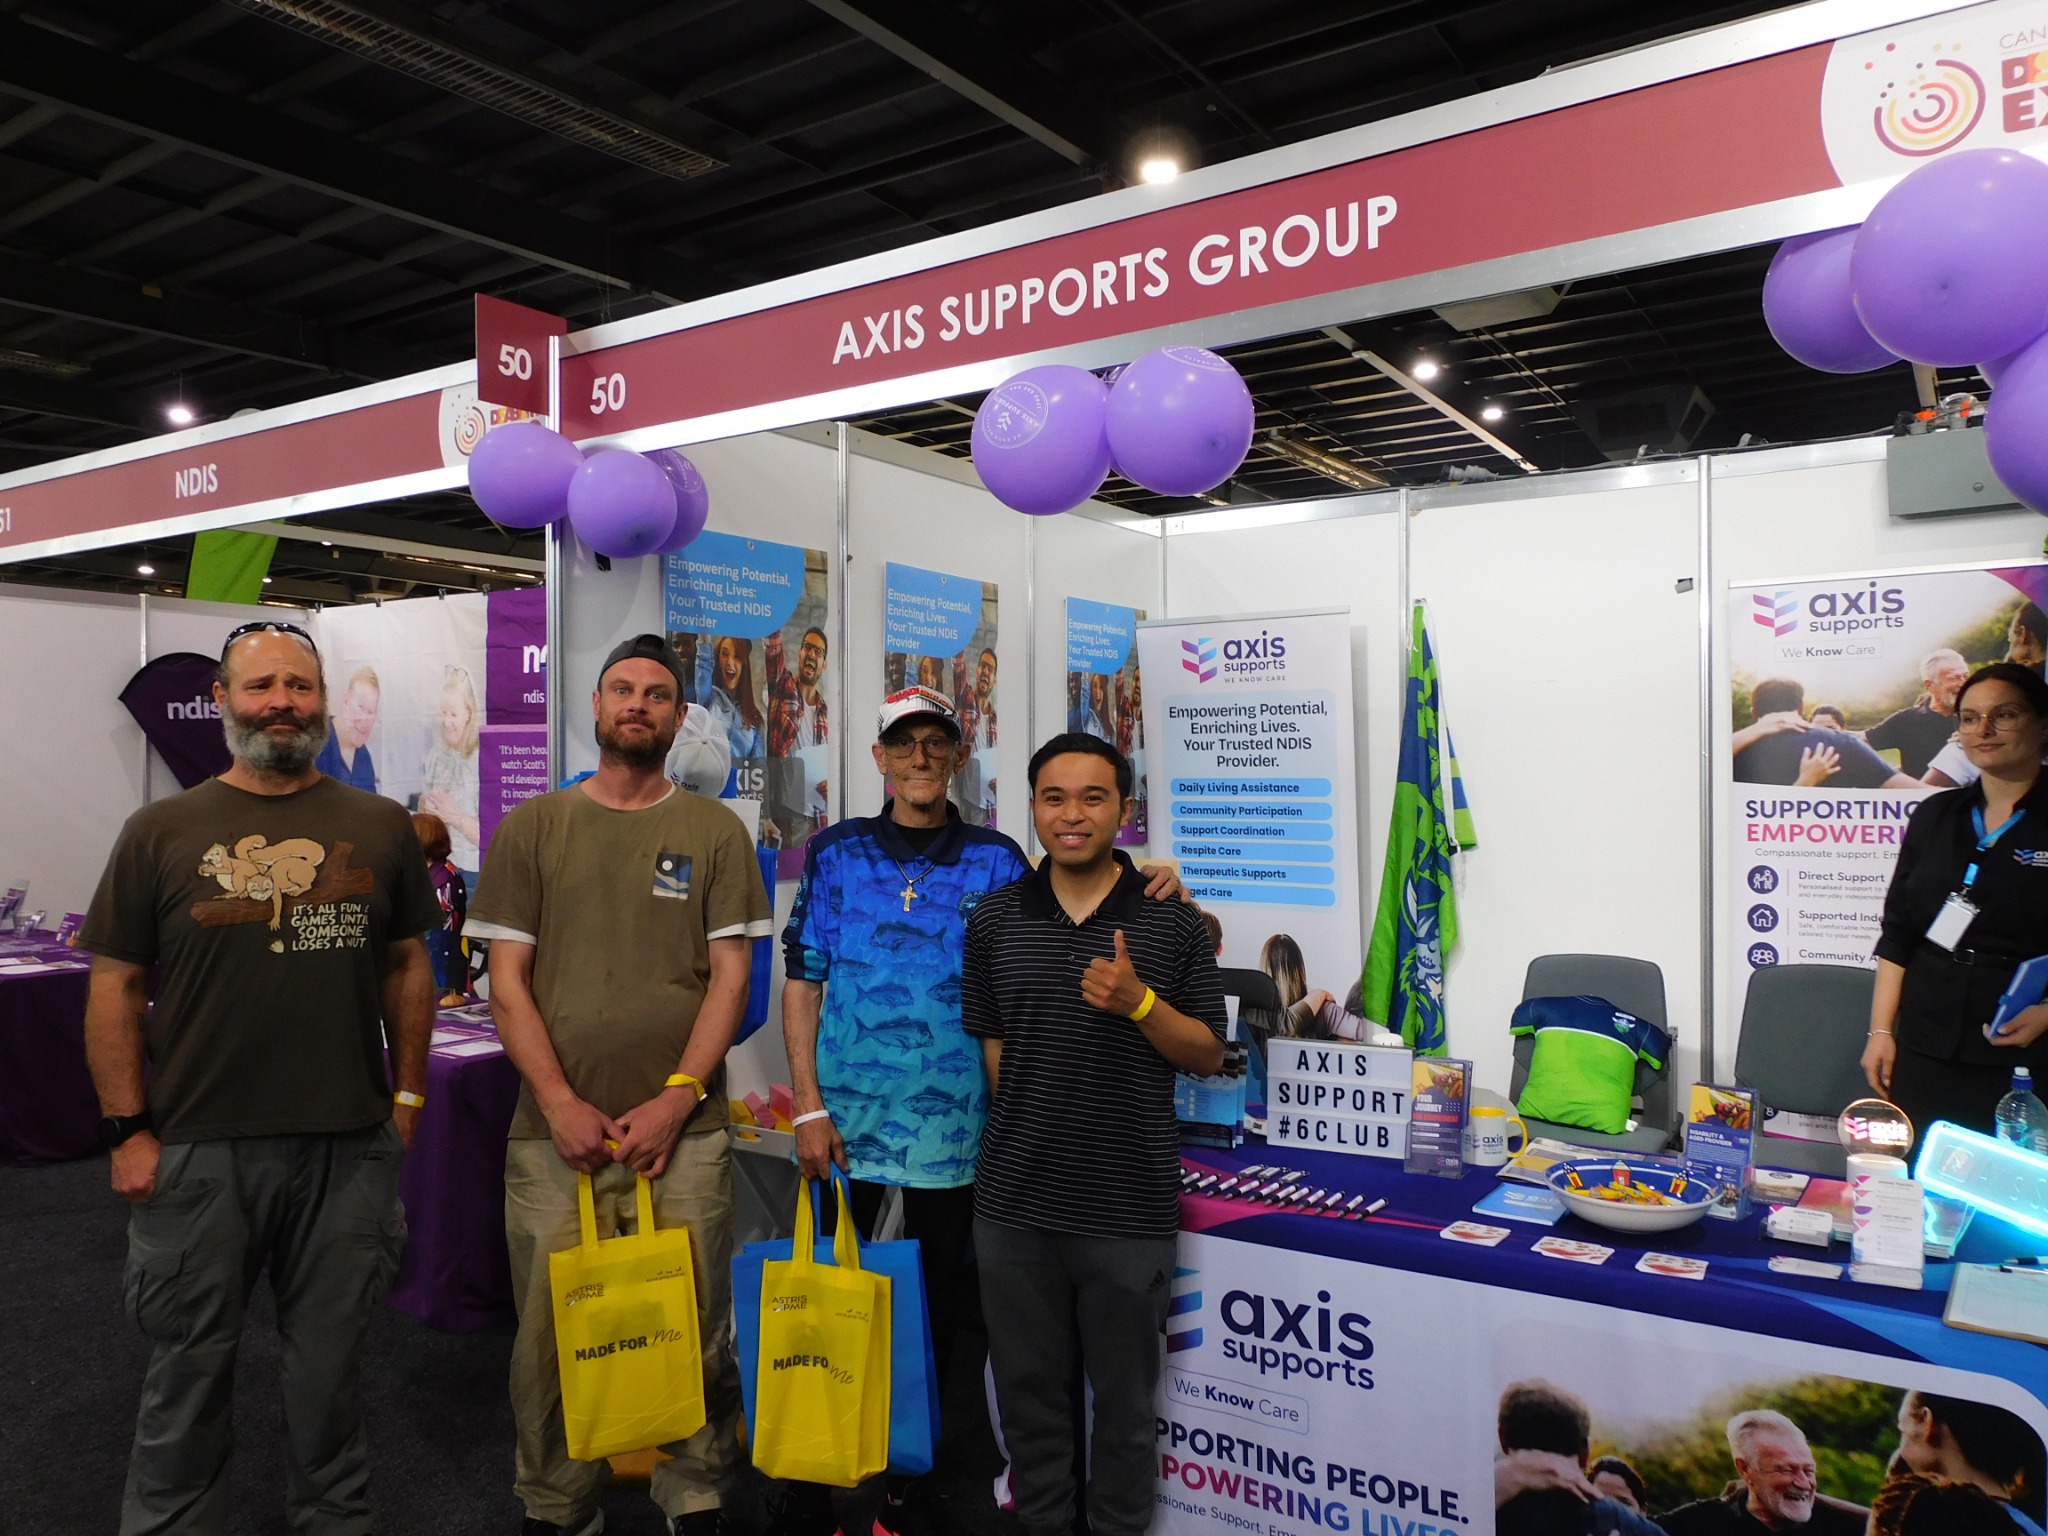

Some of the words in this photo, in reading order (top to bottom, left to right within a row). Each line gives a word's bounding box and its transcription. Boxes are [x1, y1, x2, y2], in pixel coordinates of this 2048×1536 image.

[832, 304, 924, 365] AXIS
[938, 246, 1170, 342] SUPPORTS
[1188, 194, 1398, 286] GROUP
[498, 344, 532, 380] 50
[590, 372, 626, 414] 50
[175, 463, 218, 499] NDIS
[669, 556, 739, 581] Empowering
[742, 566, 791, 588] Potential,
[669, 574, 723, 596] Enriching
[726, 580, 757, 598] Lives:
[669, 592, 696, 607] Your
[699, 596, 740, 614] Trusted
[744, 603, 772, 617] NDIS
[888, 588, 936, 610] Empowering
[937, 597, 972, 615] Potential,
[1809, 581, 1905, 618] axis
[669, 611, 718, 628] Provider
[887, 604, 924, 623] Enriching
[887, 619, 907, 632] Your
[908, 622, 937, 637] Trusted
[938, 627, 958, 640] NDIS
[1809, 615, 1904, 635] supports
[887, 635, 920, 649] Provider
[1223, 630, 1286, 660] axis
[1782, 648, 1803, 658] We
[1806, 646, 1843, 657] Know
[1845, 645, 1876, 656] Care
[1224, 658, 1286, 675] supports
[523, 691, 545, 704] ndis
[167, 696, 223, 720] ndis
[1169, 703, 1257, 720] Empowering
[1260, 701, 1328, 716] Potential,
[1190, 720, 1258, 736] Enriching
[1261, 719, 1300, 733] Lives.
[513, 745, 531, 755] been
[1183, 739, 1215, 751] Your
[1218, 737, 1273, 750] Trusted
[1276, 737, 1312, 750] NDIS
[501, 759, 522, 769] watch
[1216, 754, 1280, 767] Provider.
[501, 774, 514, 784] and
[681, 780, 699, 791] axis
[1179, 782, 1205, 795] Daily
[1207, 782, 1238, 795] Living
[1241, 783, 1300, 793] Assistance
[1180, 805, 1237, 817] Community
[1239, 806, 1303, 818] Participation
[1180, 825, 1219, 837] Support
[1220, 826, 1285, 836] Coordination
[1181, 845, 1216, 857] Respite
[1218, 846, 1241, 856] Care
[1755, 848, 1833, 859] Compassionate
[1836, 850, 1880, 860] support.
[1884, 850, 1900, 860] Em
[1182, 866, 1239, 878] Therapeutic
[1241, 868, 1286, 880] Supports
[1798, 870, 1834, 881] Direct
[1837, 871, 1885, 884] Support
[1190, 888, 1208, 897] ged
[1210, 888, 1232, 897] Care
[1798, 883, 1842, 891] Personalised
[1844, 885, 1872, 893] support
[293, 903, 314, 915] IT'S
[317, 903, 337, 914] ALL
[340, 903, 361, 913] FUN
[1799, 909, 1857, 922] Supported
[1860, 913, 1885, 922] Inde
[291, 913, 337, 927] GAMES
[1817, 923, 1858, 931] comfortable
[298, 925, 365, 940] SOMEONE
[292, 937, 331, 951] LOSES
[335, 937, 344, 948] A
[346, 938, 366, 948] NUT
[1799, 949, 1866, 963] Community
[1297, 1050, 1367, 1076] AXIS
[1279, 1082, 1404, 1114] SUPPORT
[1279, 1115, 1389, 1148] #6CLUB
[1482, 1133, 1503, 1144] axis
[564, 1282, 604, 1300] ASTRIS
[578, 1291, 604, 1302] PME
[772, 1295, 807, 1304] ASTRIS
[783, 1302, 807, 1311] PME
[1220, 1290, 1375, 1361] axis
[575, 1342, 616, 1361] MADE
[619, 1336, 648, 1352] FOR
[652, 1329, 683, 1347] Me
[773, 1354, 810, 1371] MADE
[812, 1355, 829, 1369] FO
[830, 1364, 855, 1384] Me
[1222, 1337, 1375, 1390] supports
[1174, 1376, 1200, 1398] We
[1205, 1384, 1255, 1411] Know
[1258, 1399, 1300, 1423] Care
[1156, 1416, 1316, 1485] PPORTING
[1327, 1462, 1469, 1524] PEOPLE.
[1156, 1453, 1350, 1532] POWERING
[1211, 1506, 1265, 1535] Support.
